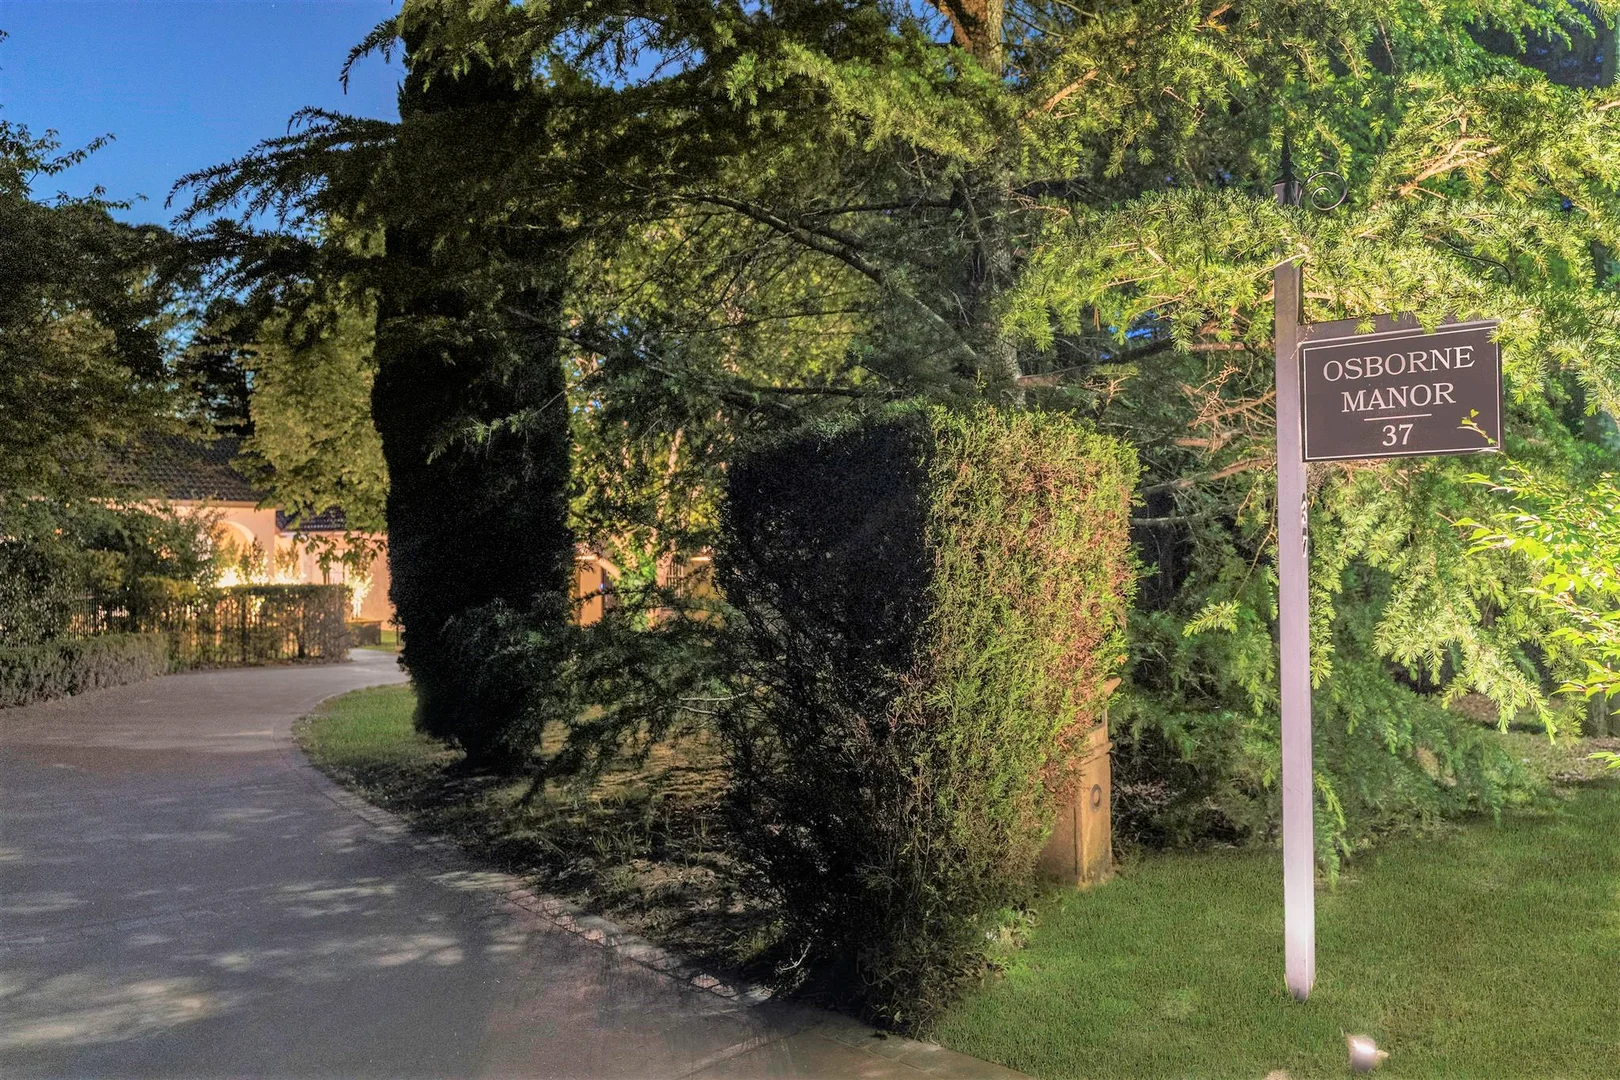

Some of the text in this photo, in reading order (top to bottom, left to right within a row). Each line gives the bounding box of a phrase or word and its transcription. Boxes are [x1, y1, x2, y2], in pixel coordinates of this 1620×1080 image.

[1323, 345, 1476, 382] OSBORNE
[1341, 382, 1456, 413] MANOR
[1382, 423, 1414, 447] 37
